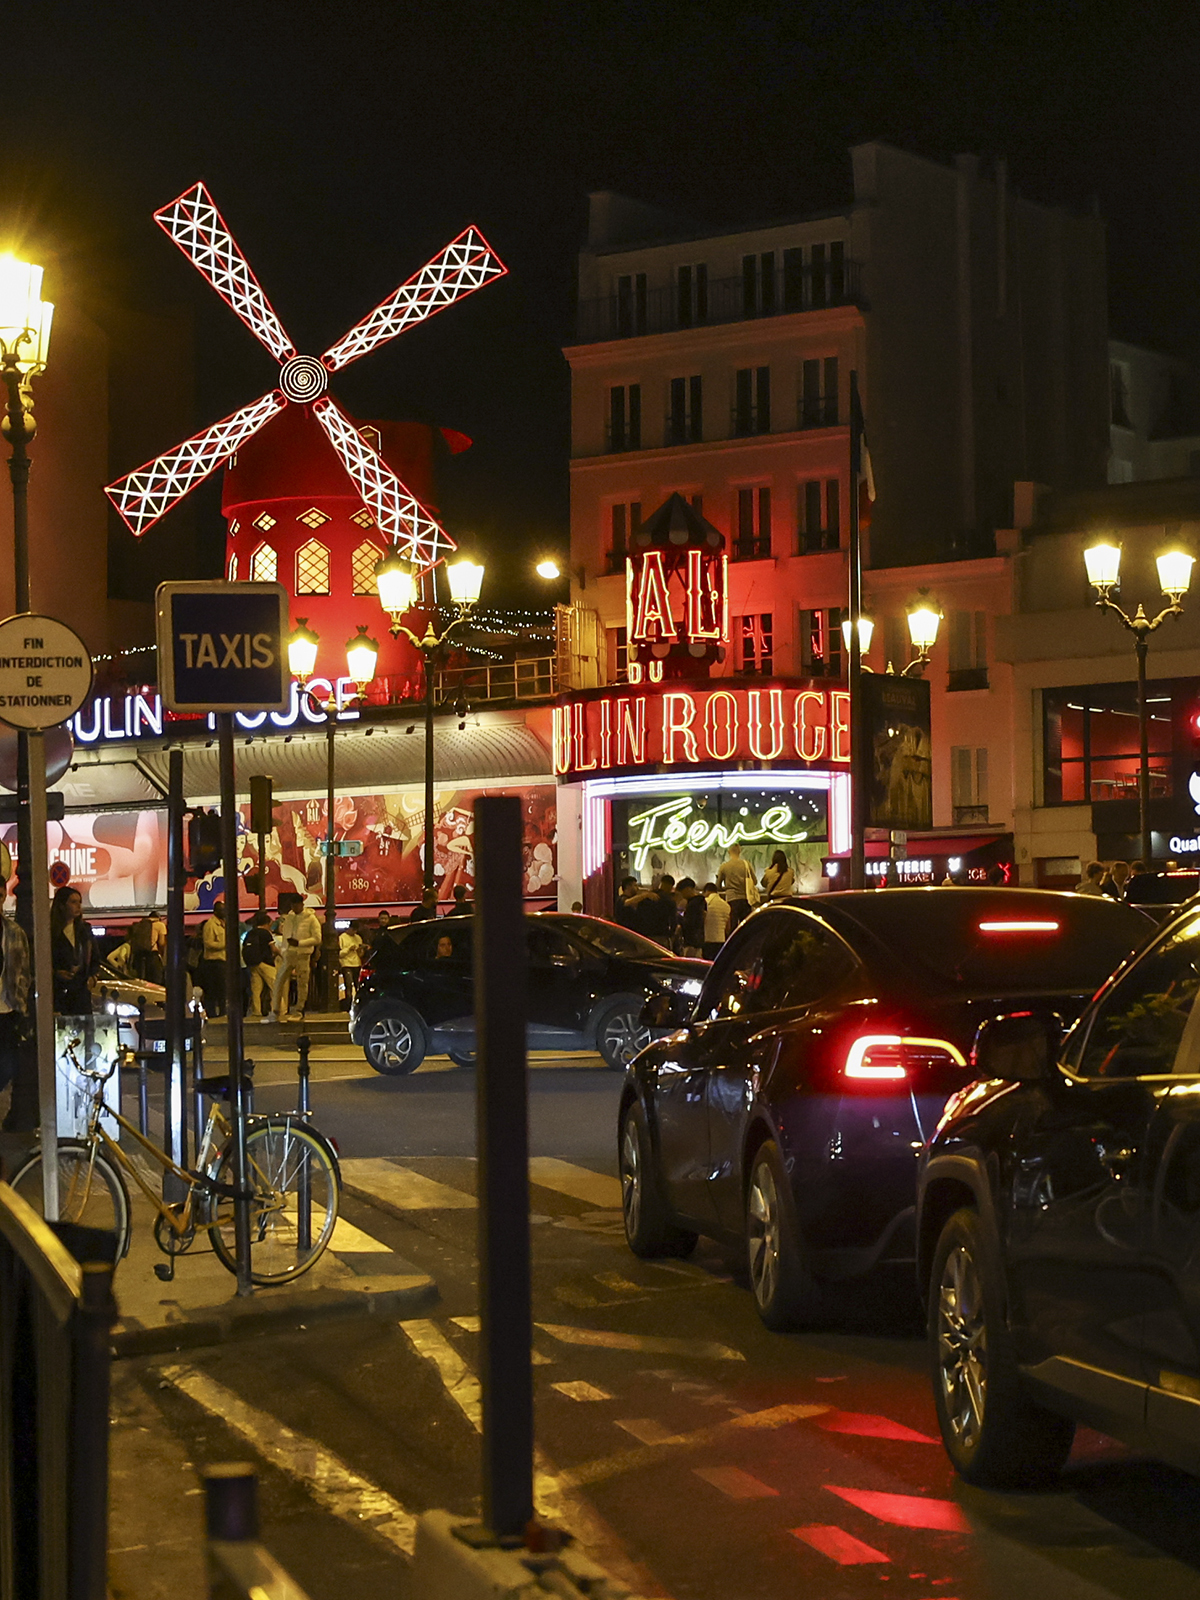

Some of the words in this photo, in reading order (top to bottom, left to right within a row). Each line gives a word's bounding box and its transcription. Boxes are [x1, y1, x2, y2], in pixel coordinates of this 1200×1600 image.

[23, 638, 44, 649] FIN
[179, 633, 275, 669] TAXIS
[26, 676, 43, 688] DE
[628, 660, 663, 684] DU
[66, 694, 163, 742] ULIN
[552, 697, 646, 775] ULIN
[662, 690, 850, 764] ROUGE
[628, 797, 807, 871] Féerie
[348, 877, 370, 892] 1889
